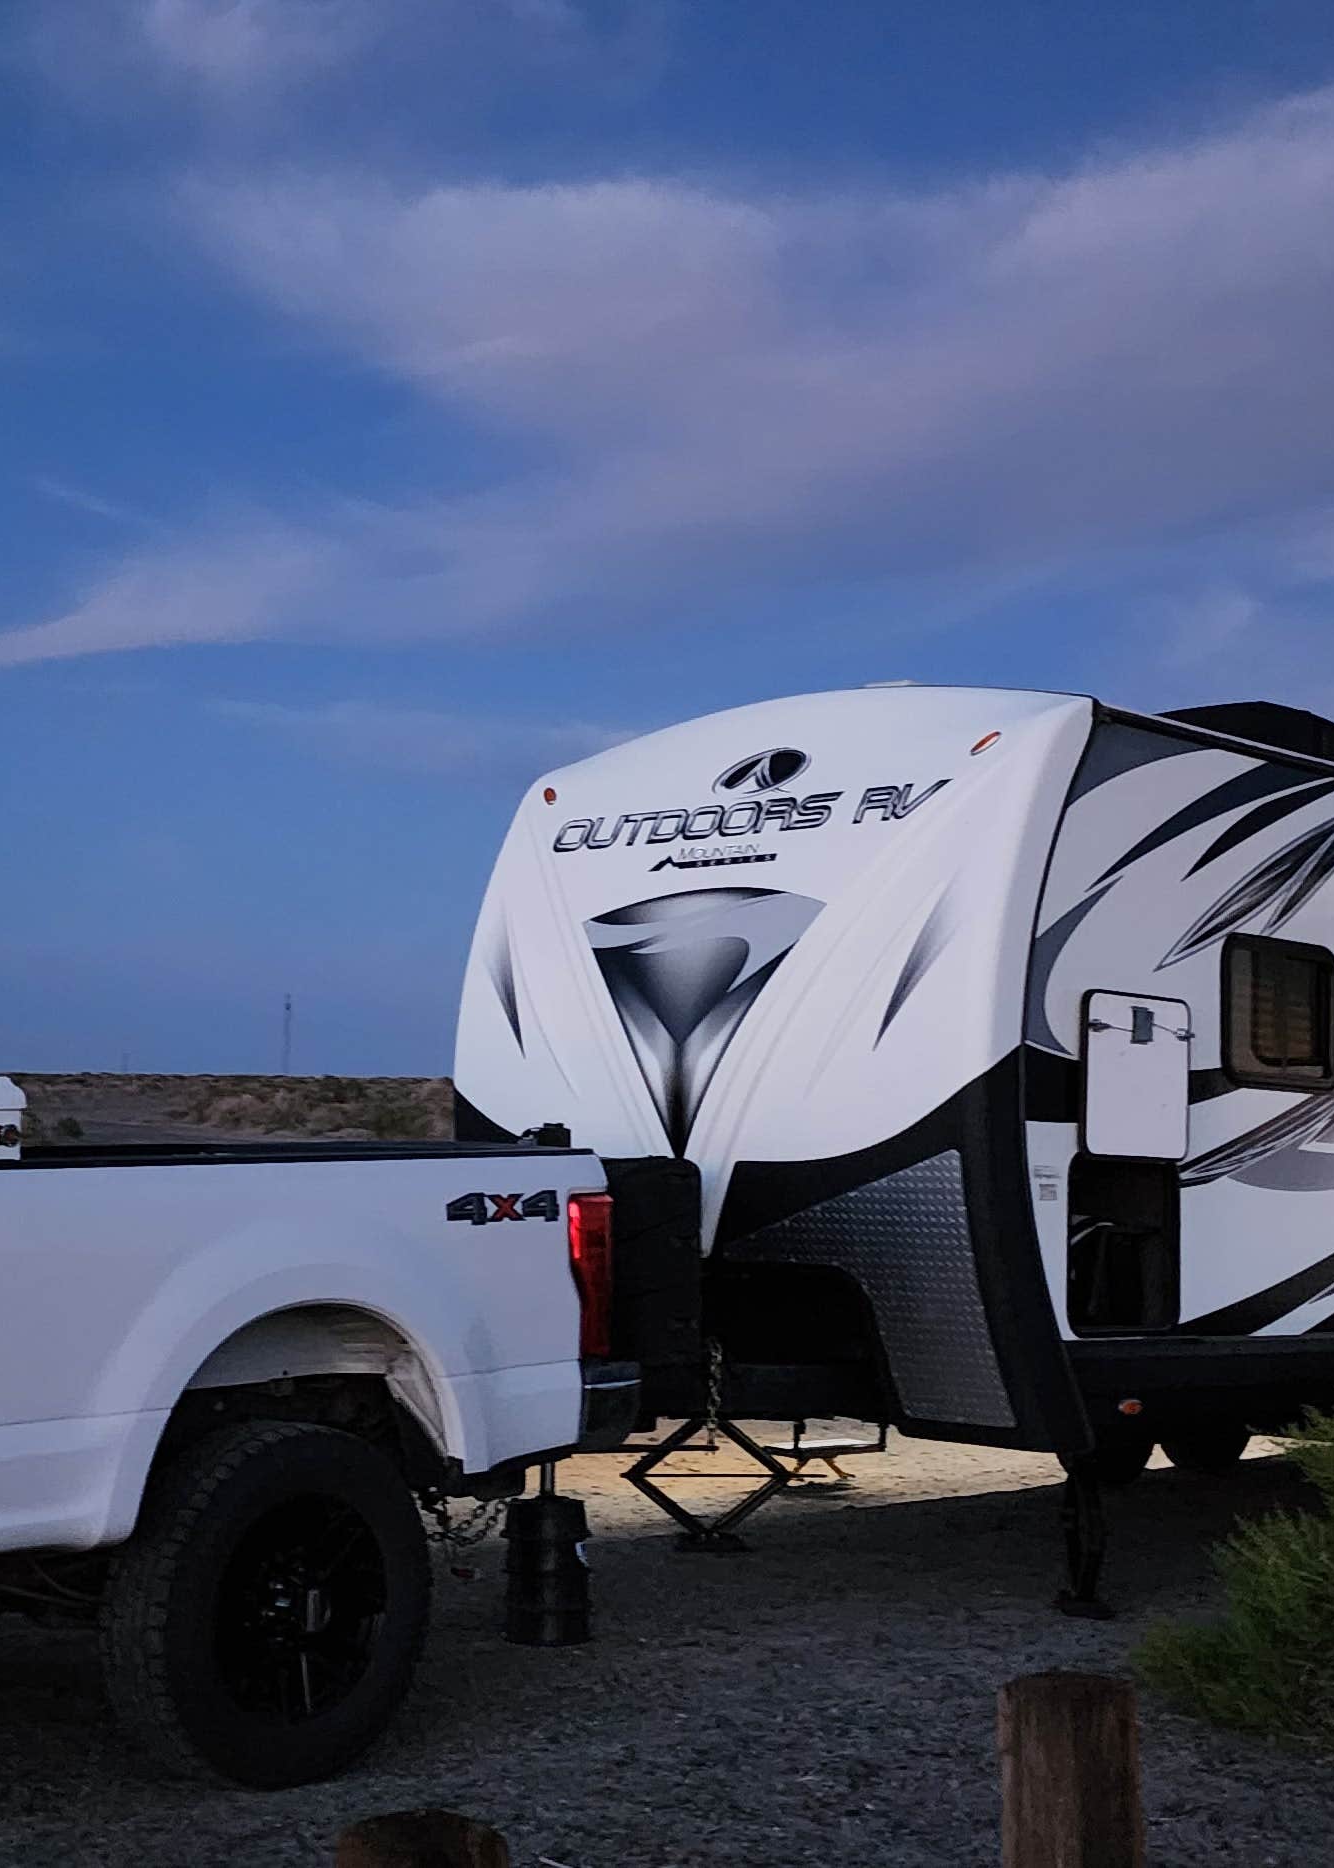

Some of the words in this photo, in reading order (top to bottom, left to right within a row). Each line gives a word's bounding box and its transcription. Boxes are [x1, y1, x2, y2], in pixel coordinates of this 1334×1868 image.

[553, 791, 845, 852] OUTDOORS
[852, 778, 954, 824] RV
[678, 843, 761, 860] MOUNTAIN
